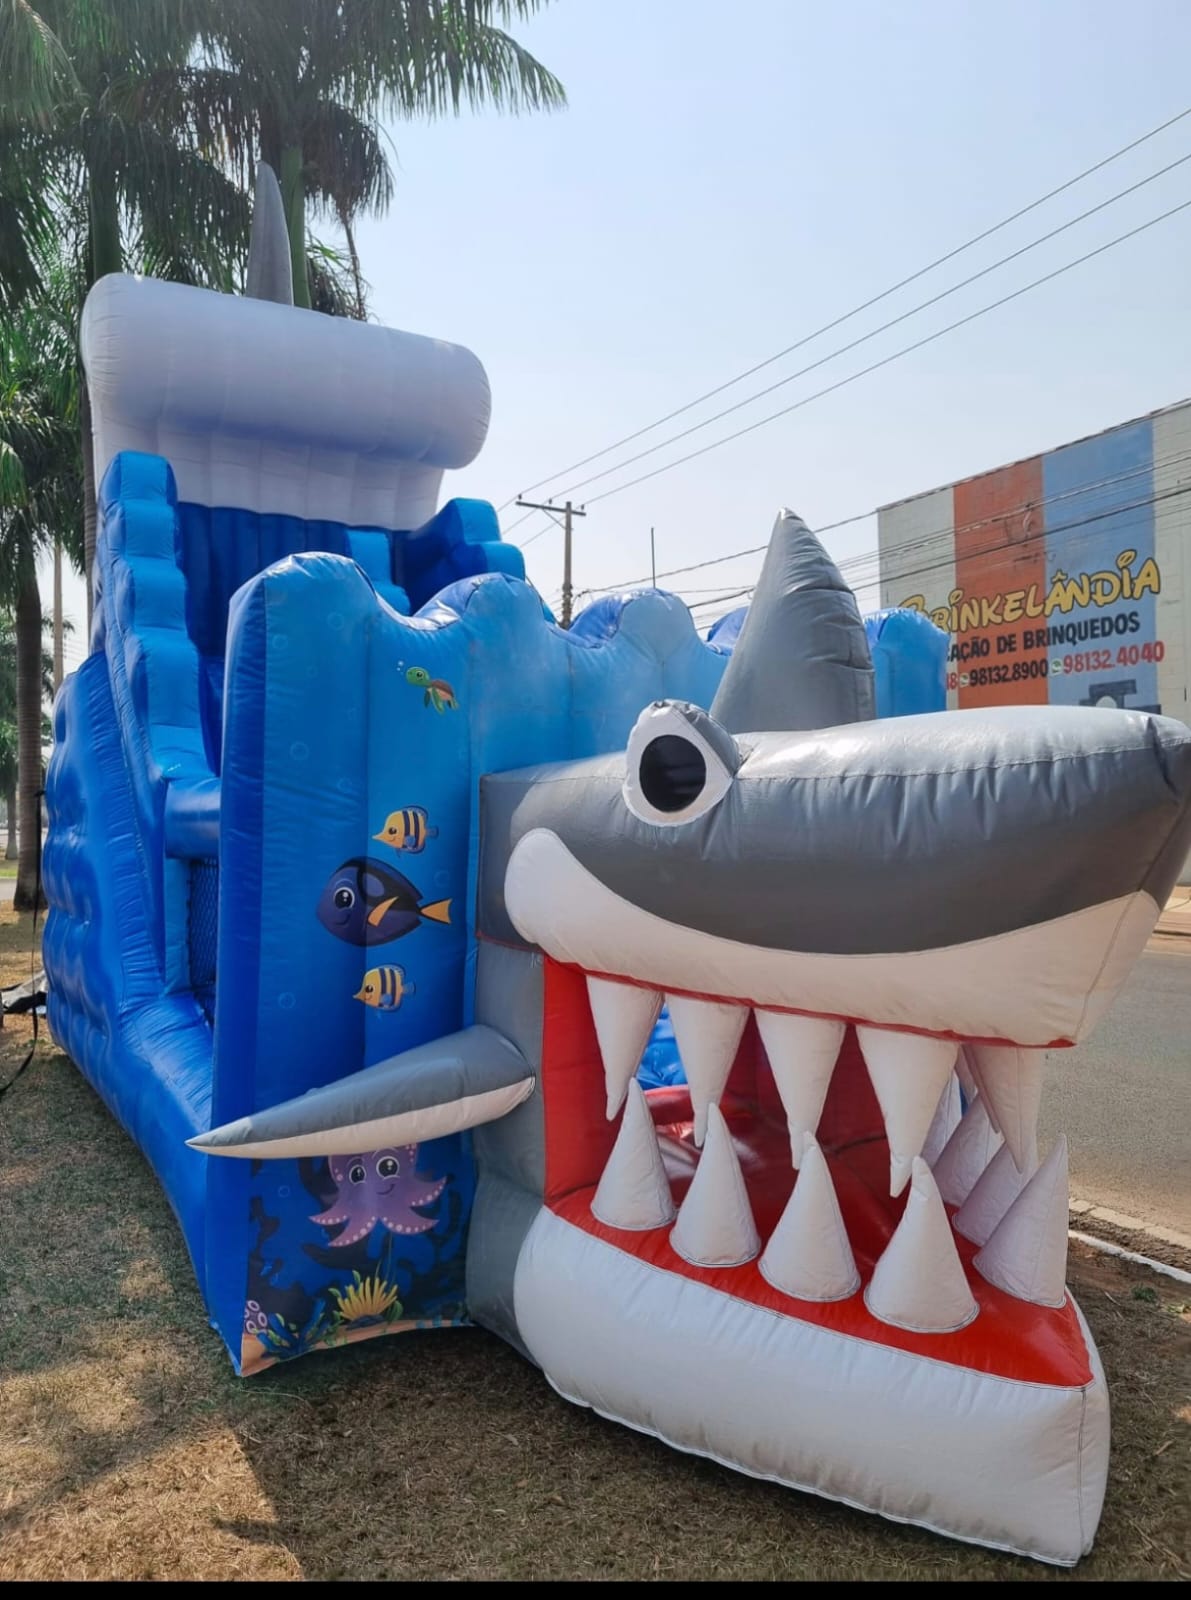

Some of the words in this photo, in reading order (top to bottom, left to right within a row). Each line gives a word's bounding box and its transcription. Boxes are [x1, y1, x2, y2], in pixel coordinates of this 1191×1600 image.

[947, 637, 990, 663] AÇÃO
[997, 634, 1017, 654] DE
[1023, 611, 1141, 651] BRINQUEDOS
[969, 659, 1049, 687] 98132.8900
[1063, 641, 1166, 675] 98132.4040
